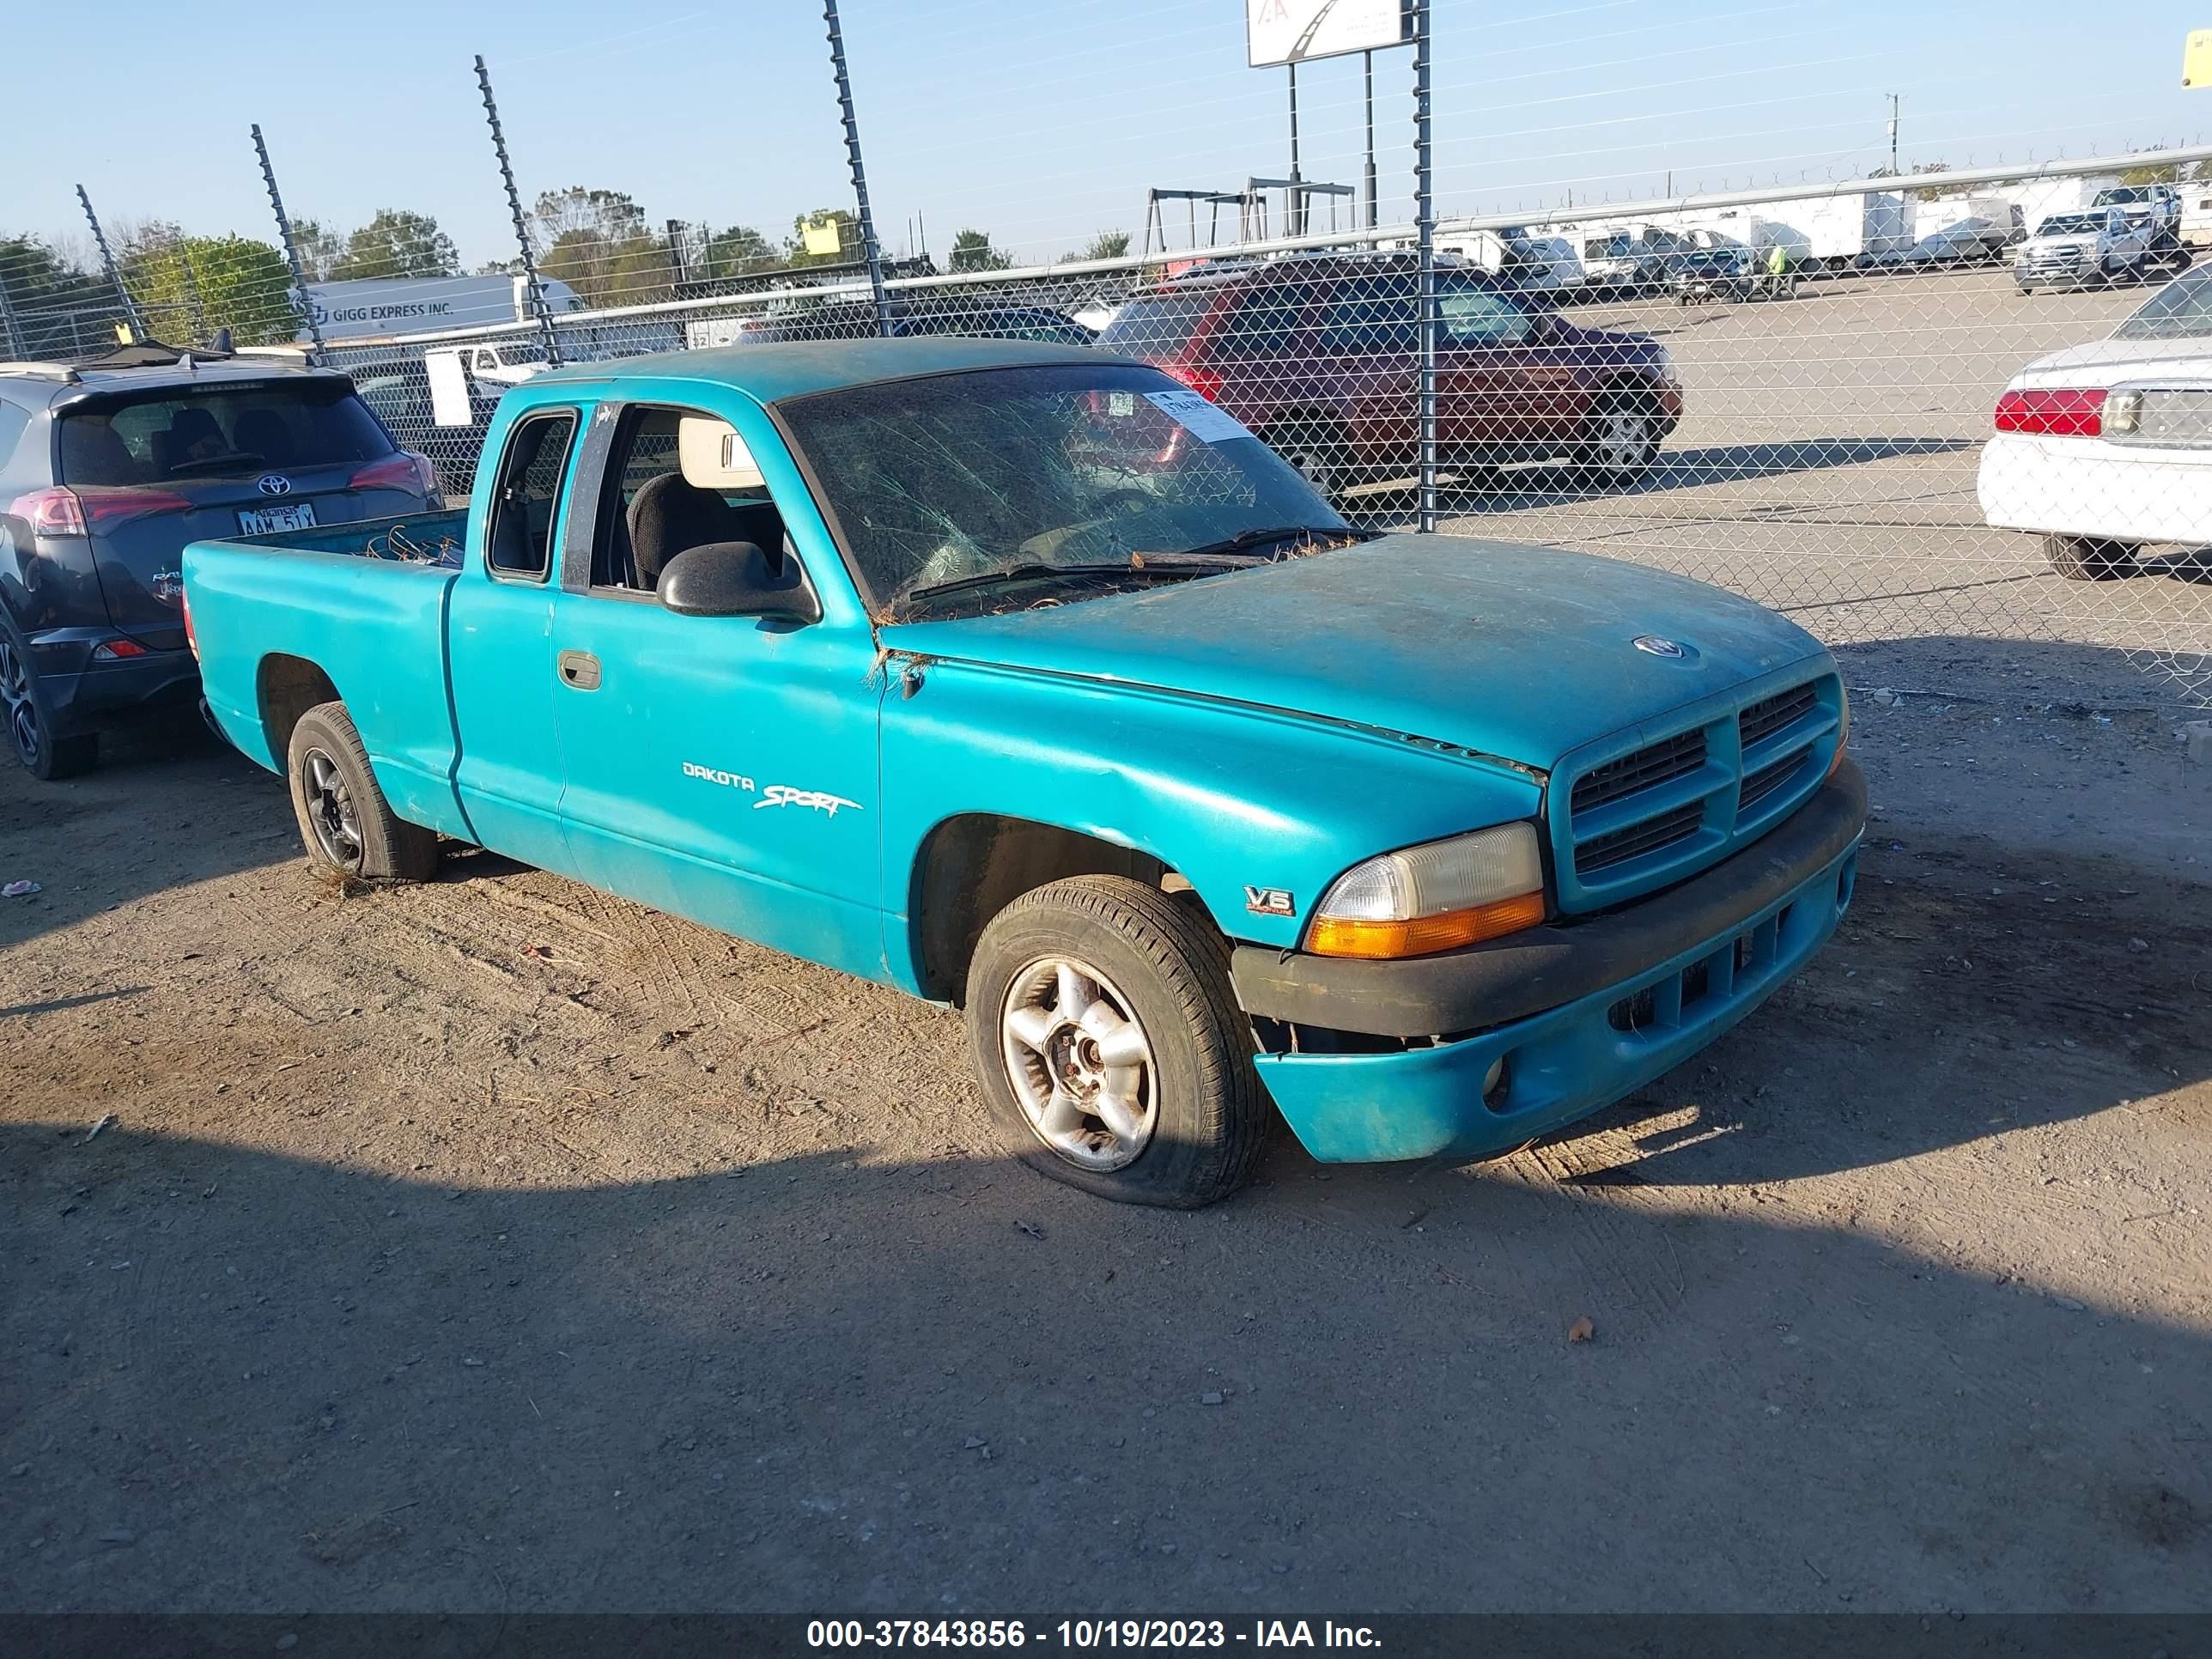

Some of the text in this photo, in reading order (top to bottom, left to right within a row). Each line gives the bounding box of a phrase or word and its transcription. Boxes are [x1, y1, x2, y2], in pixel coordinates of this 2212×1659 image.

[333, 307, 367, 322] GIGG
[371, 303, 425, 319] EXPRESS
[428, 302, 454, 316] INC.
[682, 761, 866, 818] DAKOTA SPORT
[1243, 885, 1291, 909] V6
